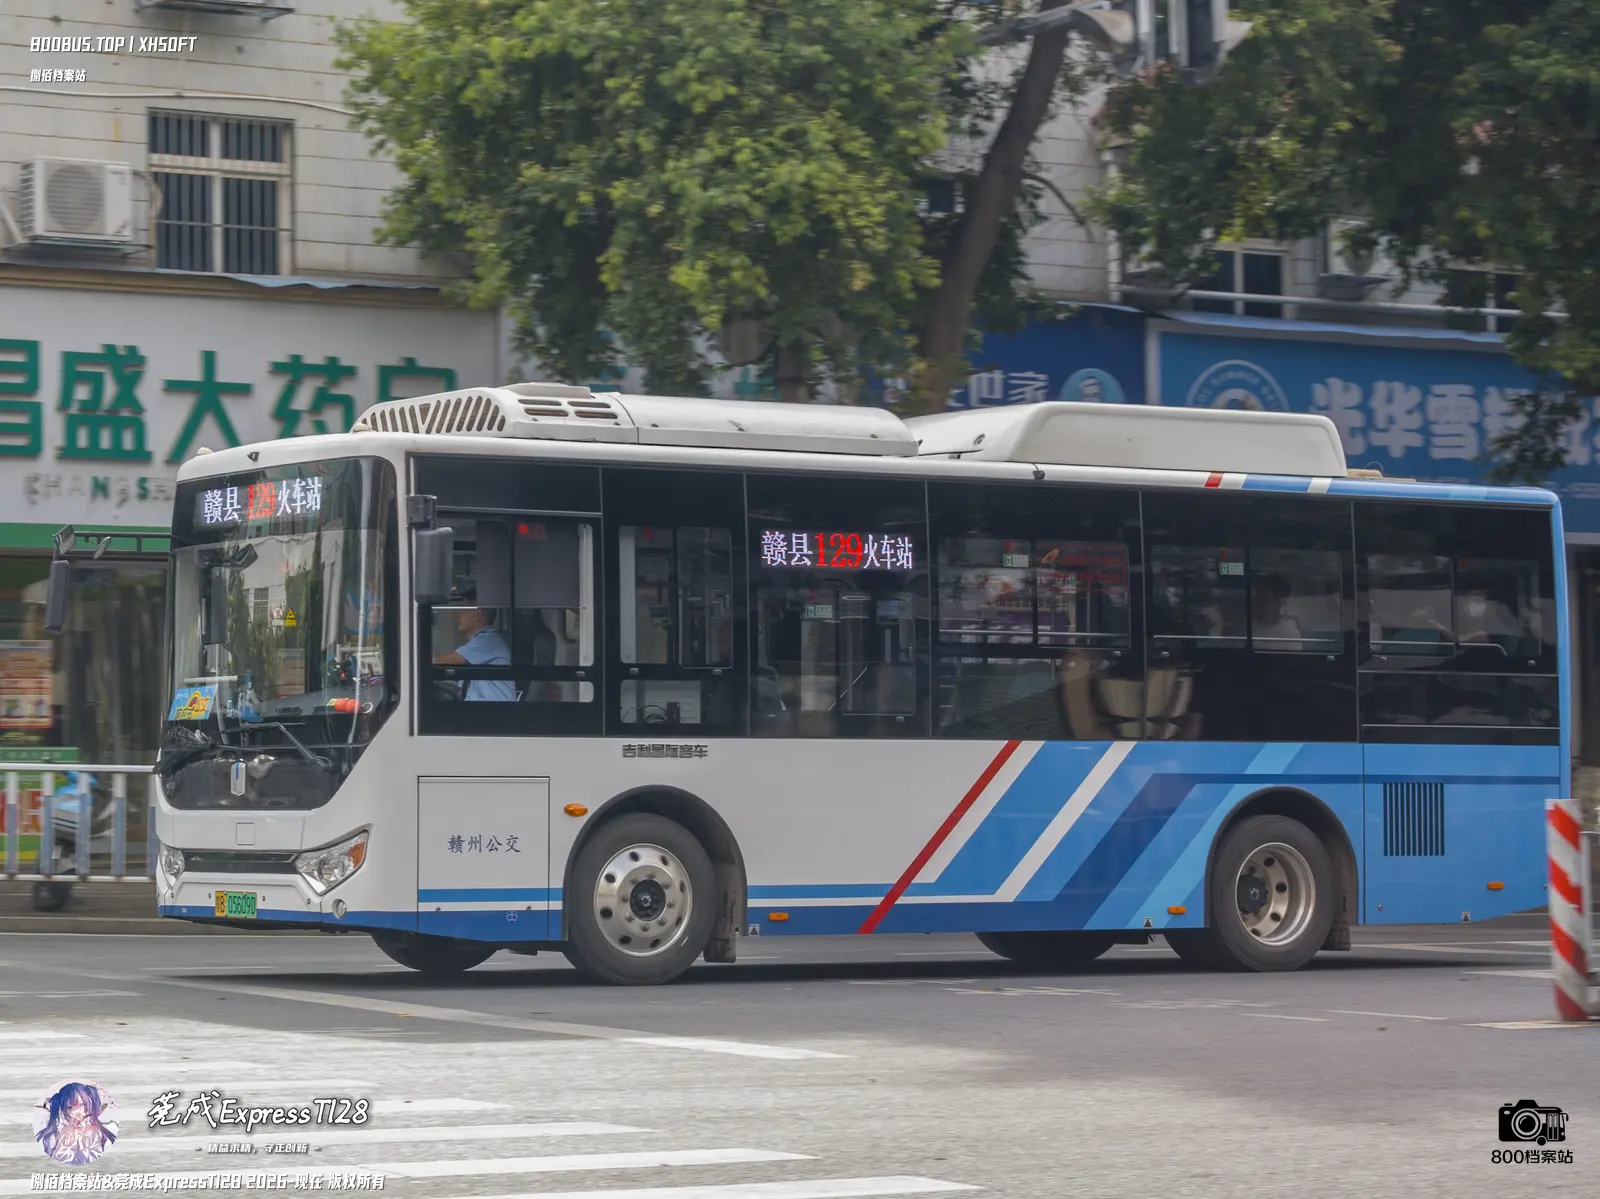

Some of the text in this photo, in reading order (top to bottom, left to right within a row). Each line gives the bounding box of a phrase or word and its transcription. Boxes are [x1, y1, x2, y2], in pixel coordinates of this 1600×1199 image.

[247, 481, 276, 519] 129
[277, 476, 322, 516] 火车站
[761, 531, 913, 569] 赣县 129 火车站
[448, 834, 521, 854] 赣州公交
